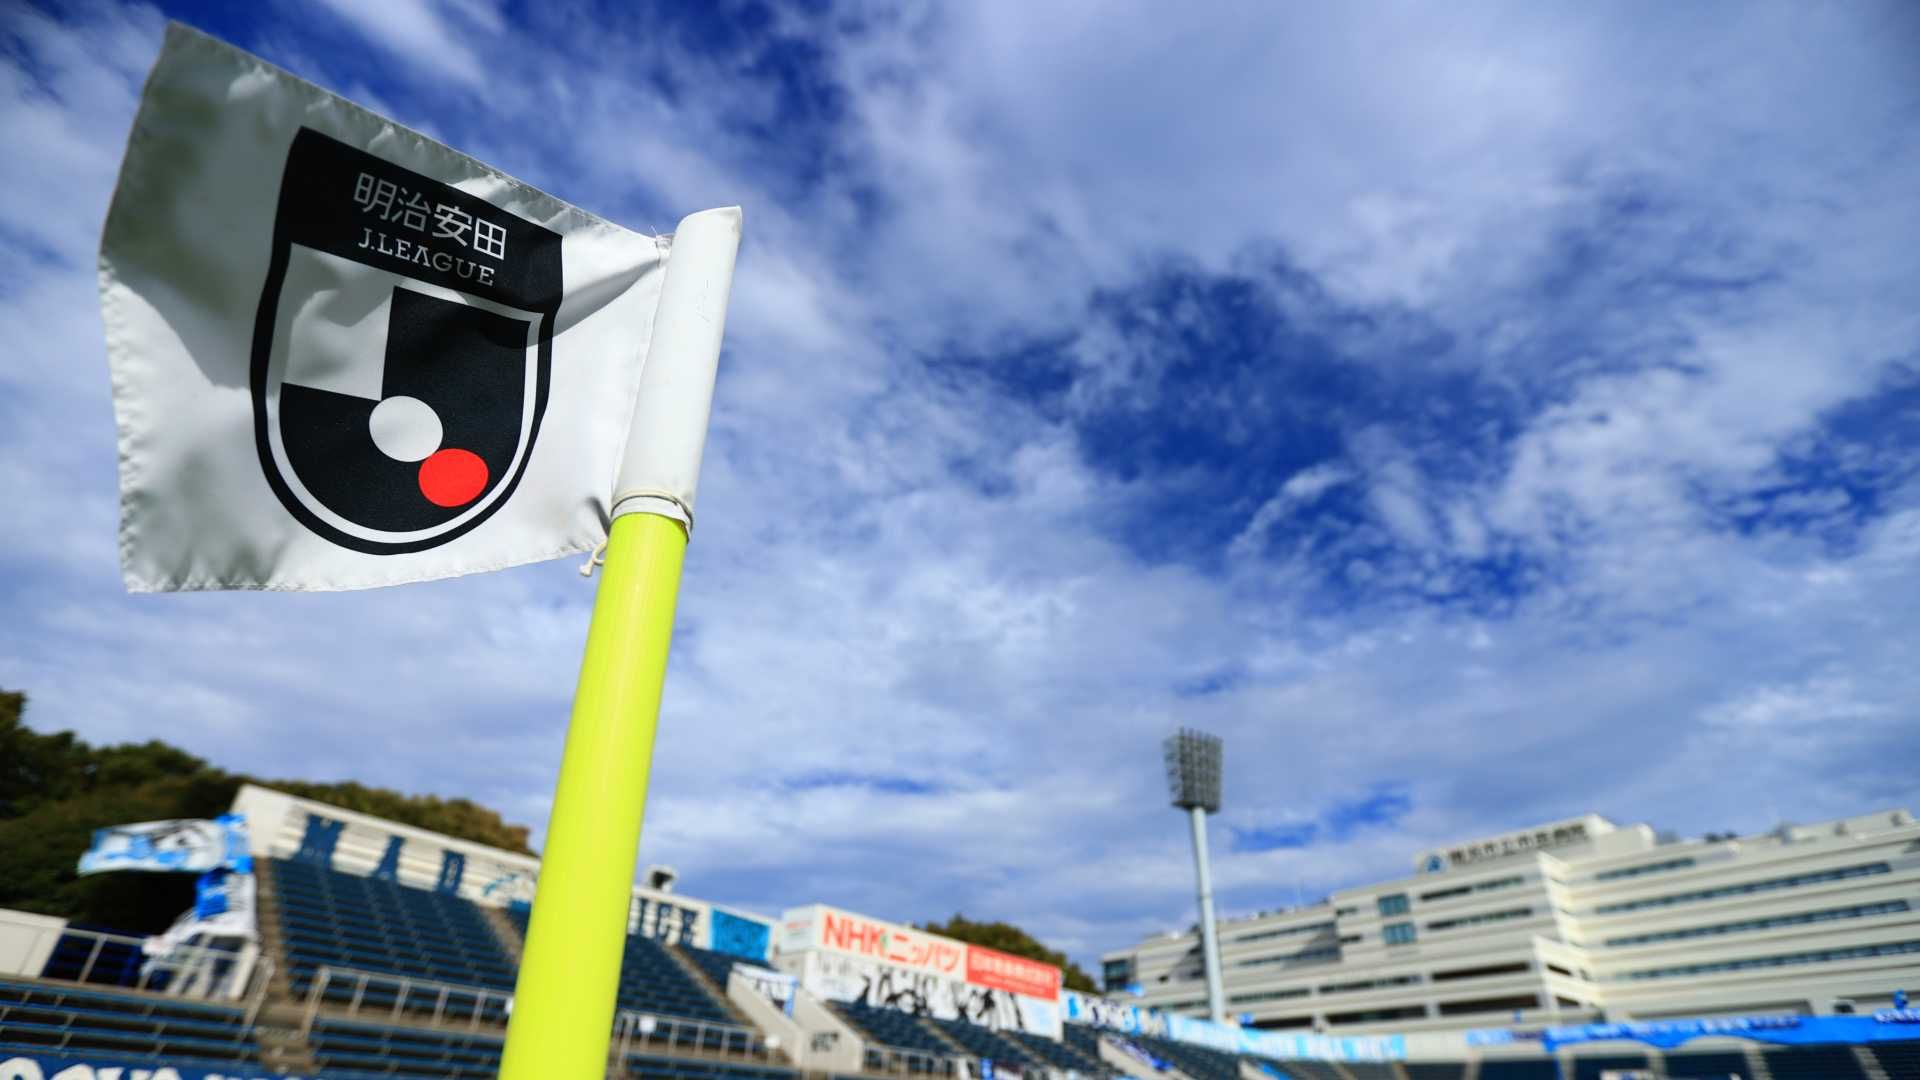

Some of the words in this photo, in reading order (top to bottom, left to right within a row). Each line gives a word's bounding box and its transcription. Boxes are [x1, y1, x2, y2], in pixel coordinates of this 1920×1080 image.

[353, 172, 507, 261] 明治安田
[358, 227, 496, 287] J.LEAGUE
[823, 910, 886, 958] NHK
[887, 932, 961, 973] ニッパツ
